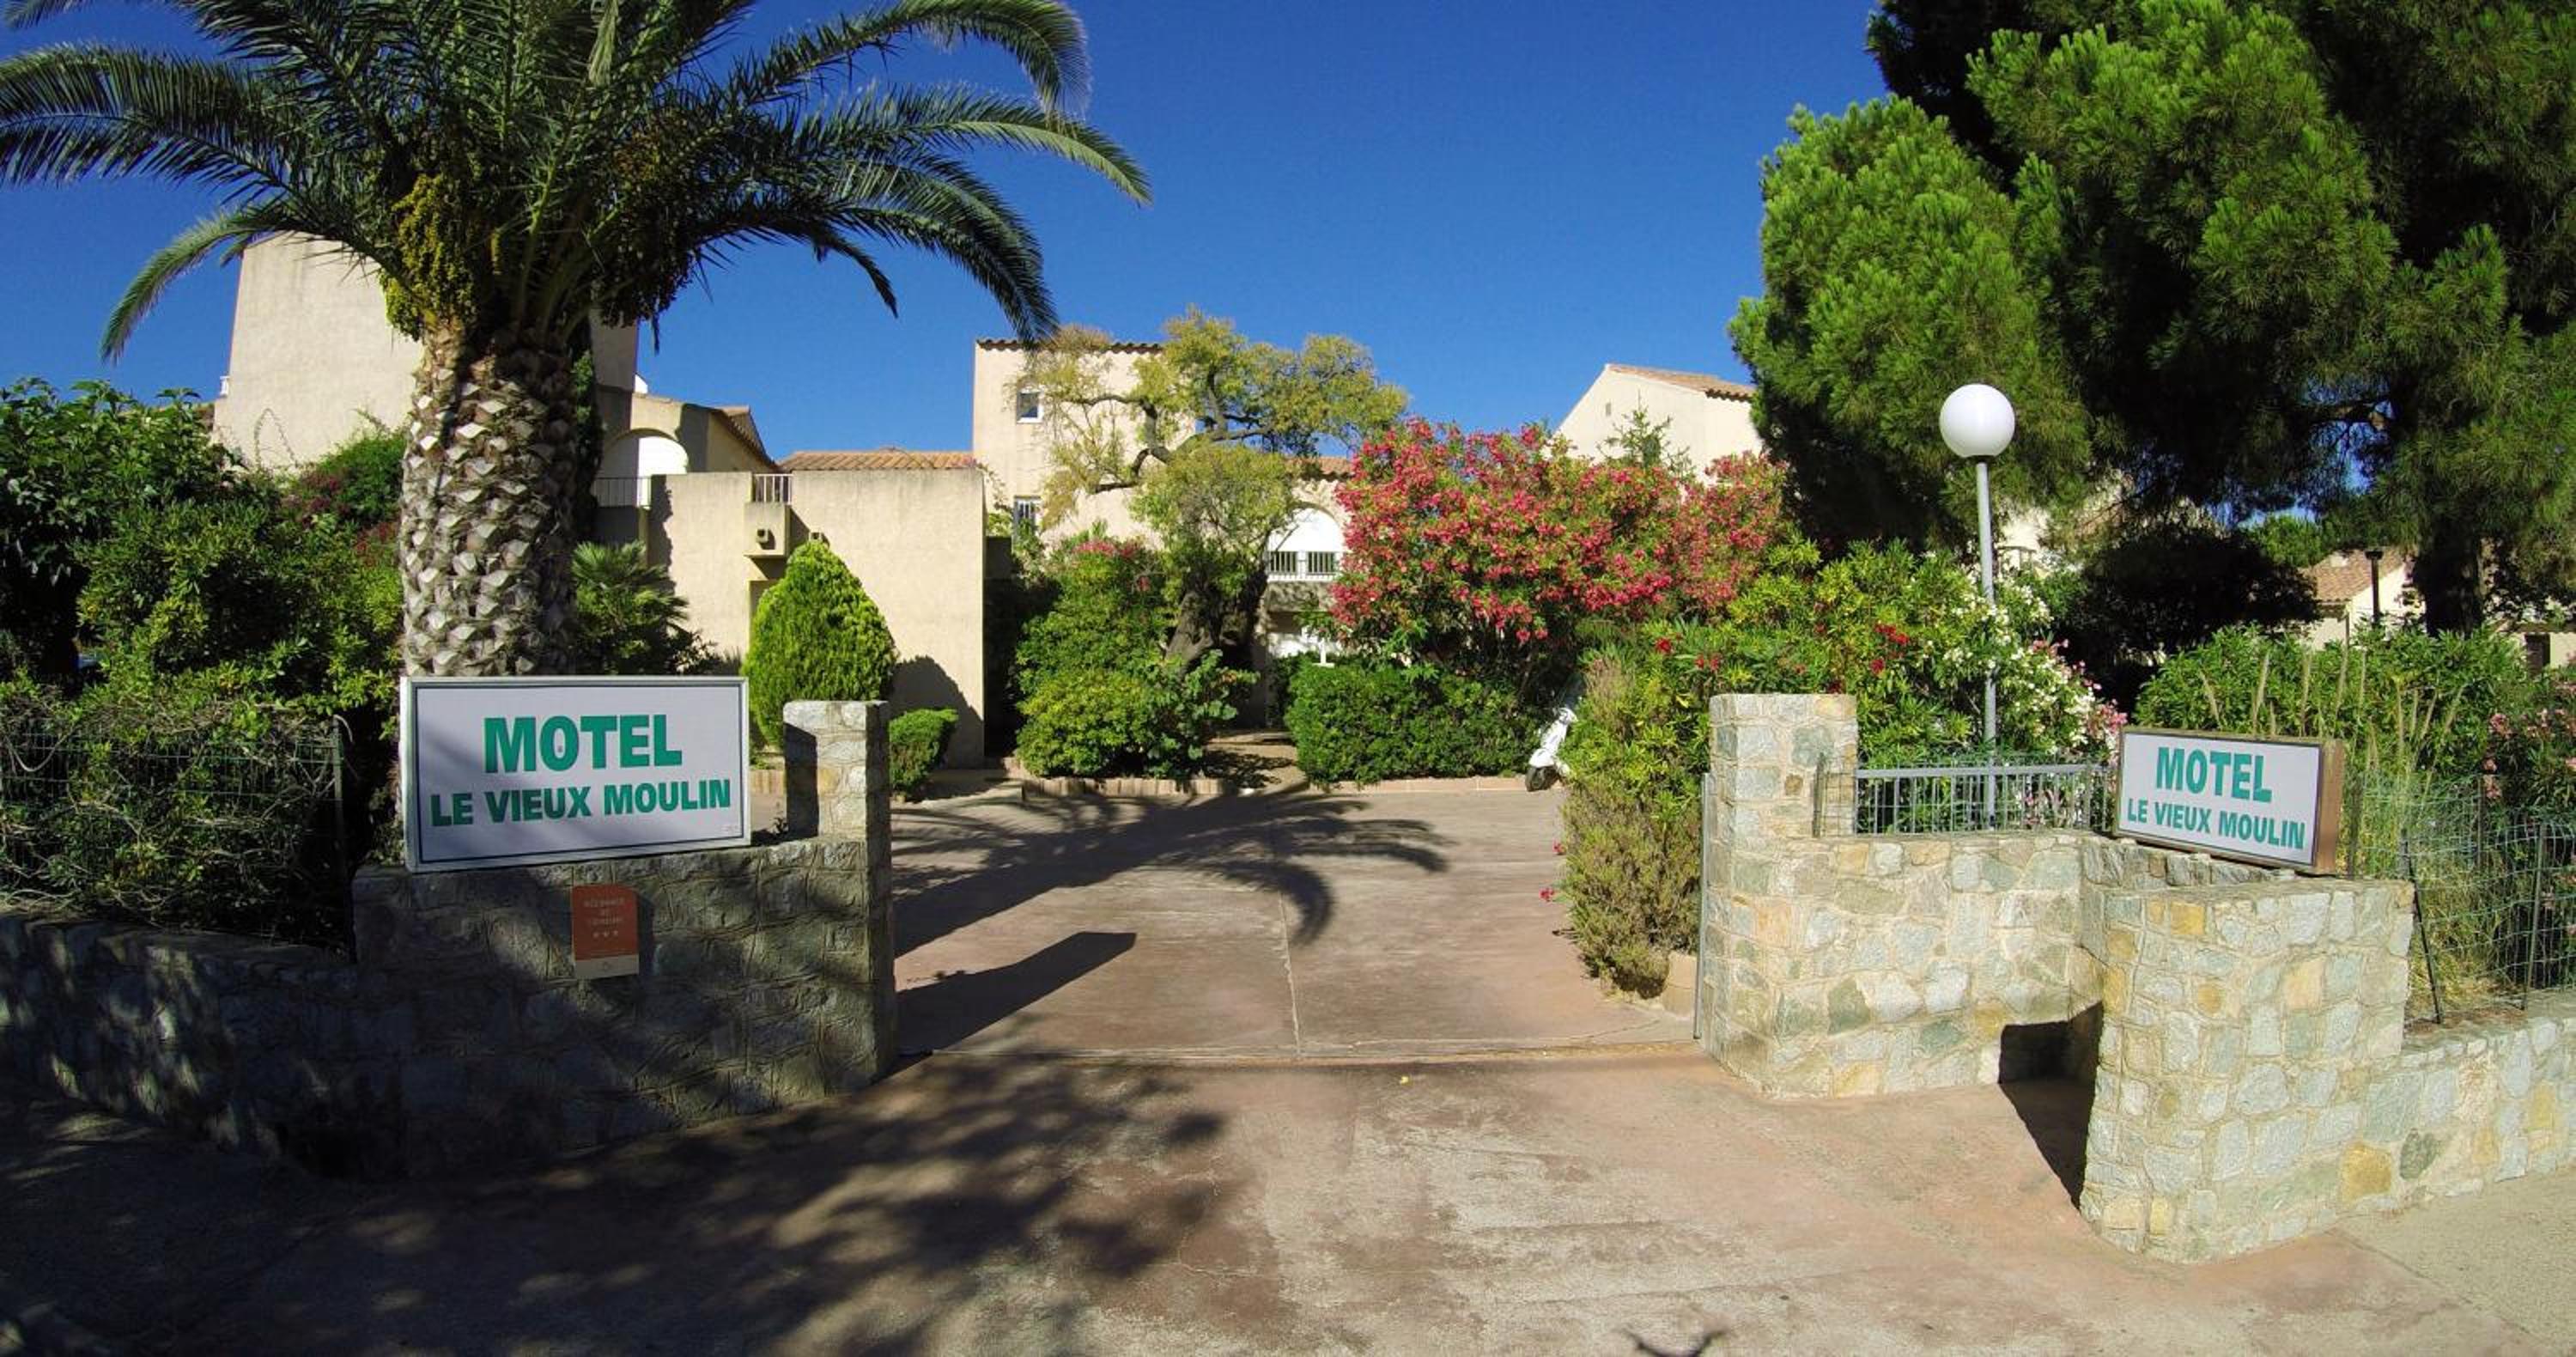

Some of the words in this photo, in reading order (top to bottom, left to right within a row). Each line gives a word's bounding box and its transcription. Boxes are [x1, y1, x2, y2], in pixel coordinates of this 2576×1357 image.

[483, 714, 683, 773] MOTEL
[2157, 746, 2272, 803] MOTEL
[431, 793, 473, 826] LE
[484, 786, 591, 823] VIEUX
[605, 779, 731, 815] MOULIN
[2127, 798, 2148, 824] LE
[2154, 802, 2212, 834] VIEUX
[2218, 811, 2306, 849] MOULIN
